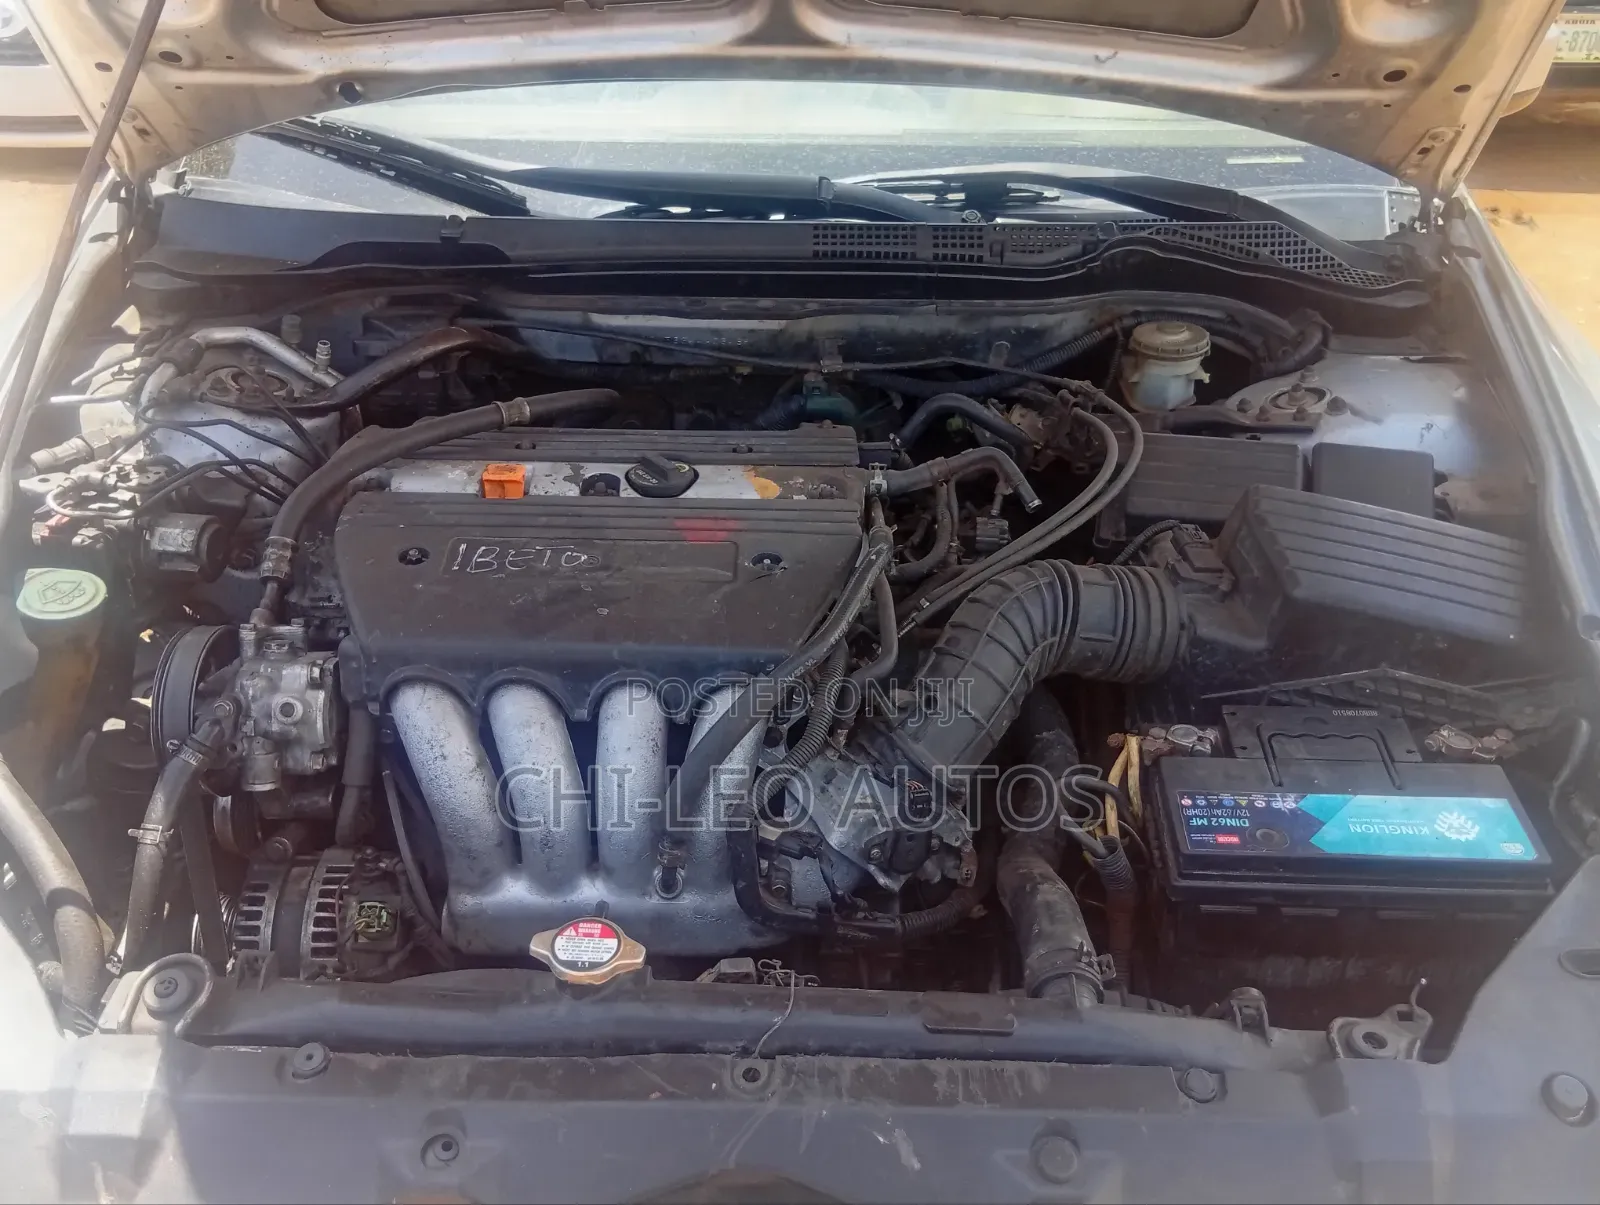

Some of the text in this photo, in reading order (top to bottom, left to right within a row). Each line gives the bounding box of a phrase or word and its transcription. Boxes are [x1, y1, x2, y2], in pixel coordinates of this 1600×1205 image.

[1189, 817, 1250, 827] DIN62 MF
[1348, 823, 1430, 836] KINGLION
